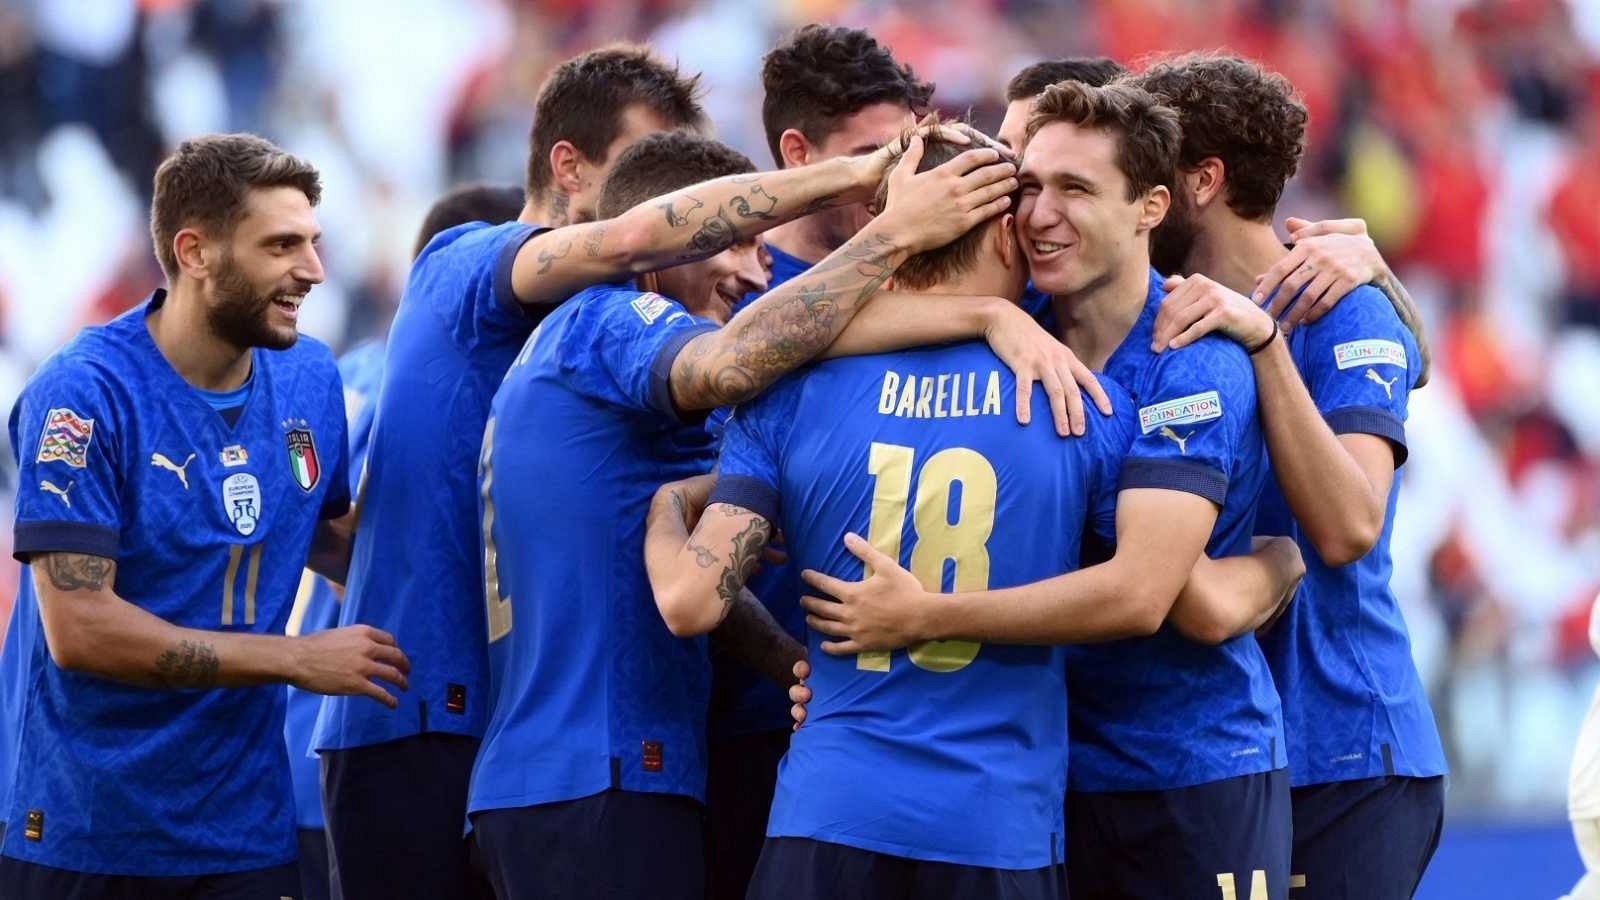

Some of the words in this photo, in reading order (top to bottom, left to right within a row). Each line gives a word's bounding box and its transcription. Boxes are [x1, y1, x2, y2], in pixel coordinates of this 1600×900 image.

[878, 370, 1001, 418] BARELLA
[1142, 399, 1218, 425] FOUNDATION
[221, 543, 262, 625] 11
[856, 442, 998, 672] 18
